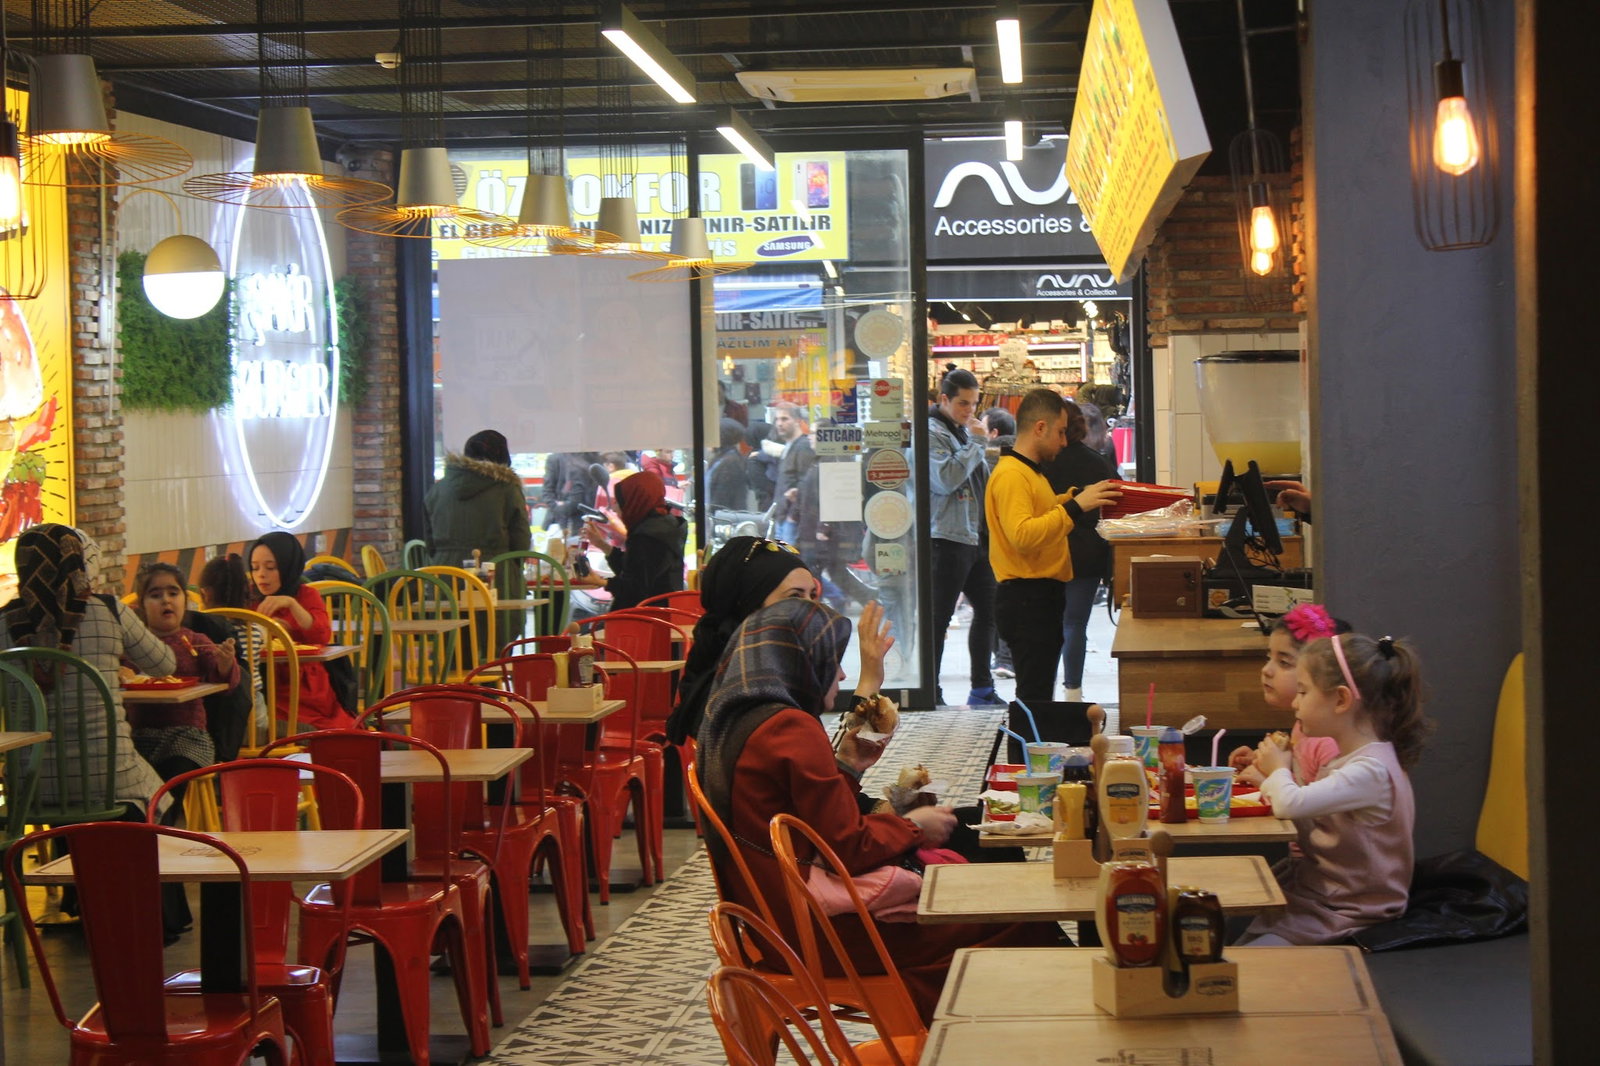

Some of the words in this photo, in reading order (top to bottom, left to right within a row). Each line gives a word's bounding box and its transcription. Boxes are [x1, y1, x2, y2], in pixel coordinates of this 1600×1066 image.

[571, 172, 722, 216] ONFOR
[934, 214, 1072, 236] Accessories
[762, 238, 813, 251] SAMSUNG
[1036, 289, 1076, 297] Accessories
[1084, 288, 1118, 296] Collection
[717, 338, 771, 349] AZILIM
[816, 429, 862, 442] SETCARD
